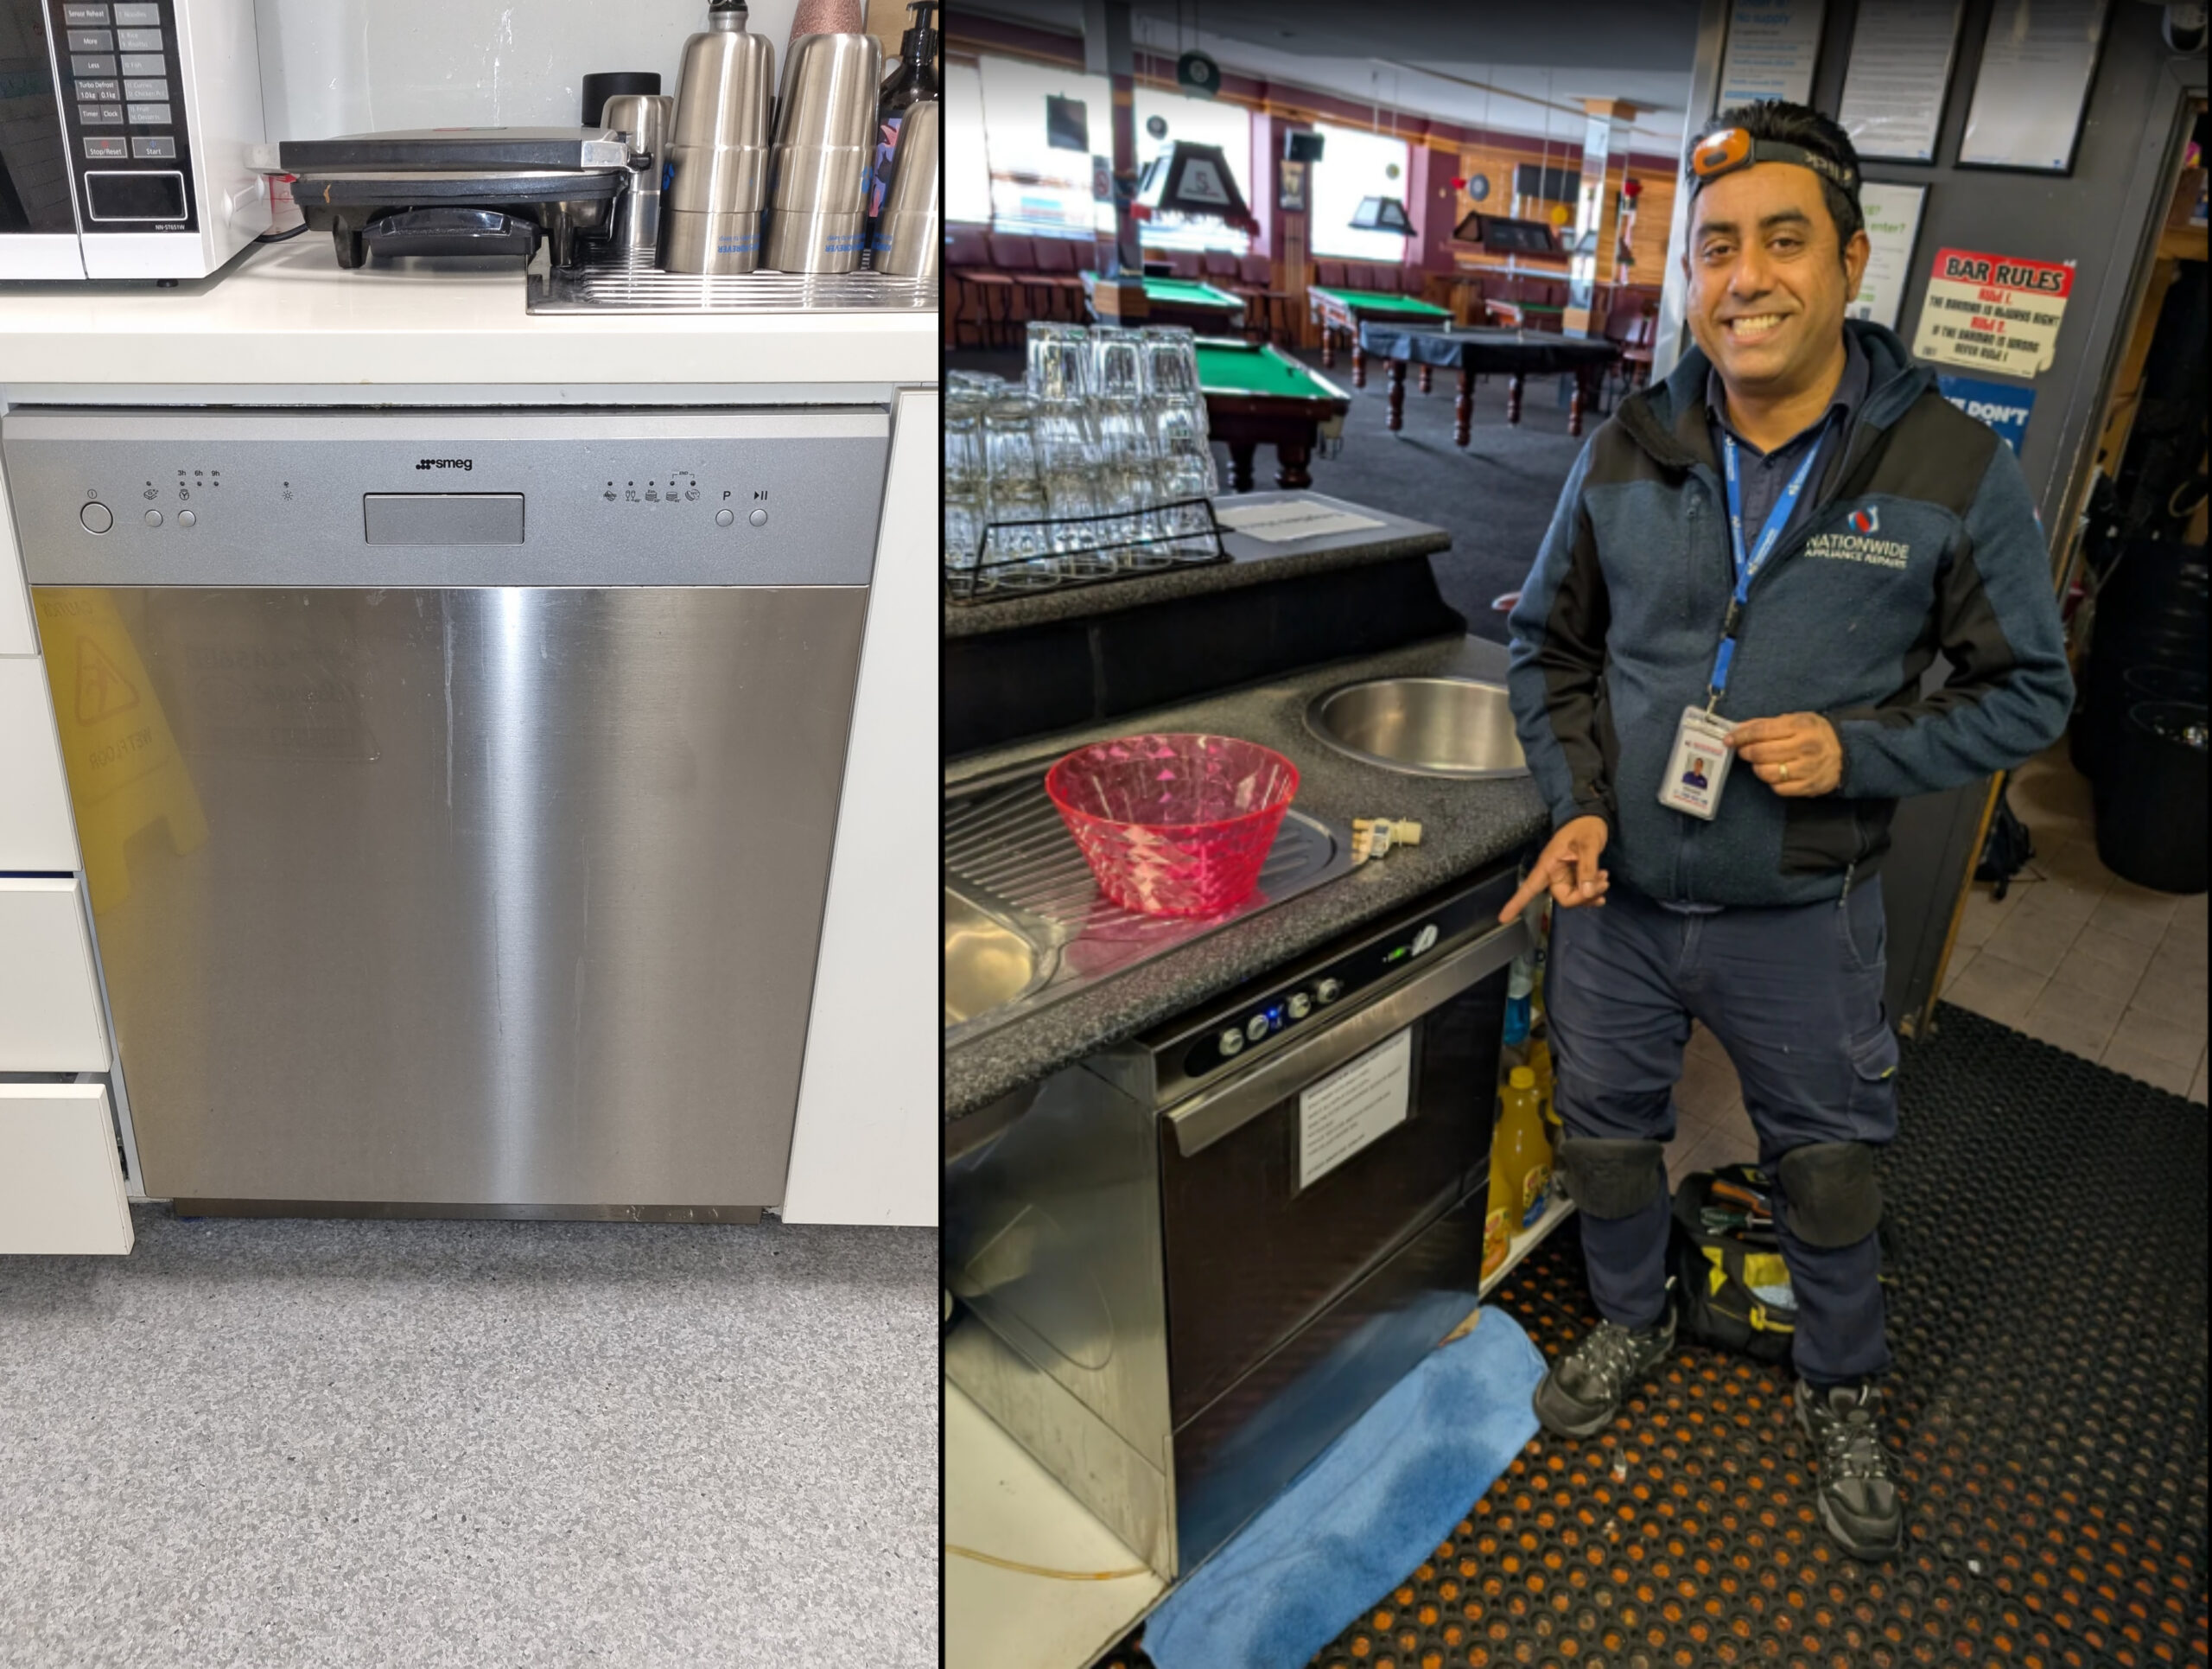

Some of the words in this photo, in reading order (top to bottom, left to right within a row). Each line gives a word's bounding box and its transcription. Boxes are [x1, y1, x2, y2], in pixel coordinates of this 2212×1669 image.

[89, 148, 122, 156] Stop/Reset
[1947, 256, 1990, 282] BAR
[1995, 264, 2064, 292] RULES
[1929, 295, 1944, 309] THE
[1982, 304, 1993, 315] IS
[1932, 324, 1942, 335] IF
[1942, 327, 1956, 339] THE
[1997, 335, 2006, 347] IS
[1967, 401, 2029, 426] DON'T
[435, 459, 473, 472] smeg
[722, 490, 731, 501] P
[1804, 549, 1863, 562] APPLIANCE
[1806, 532, 1910, 560] NATIONWIDE
